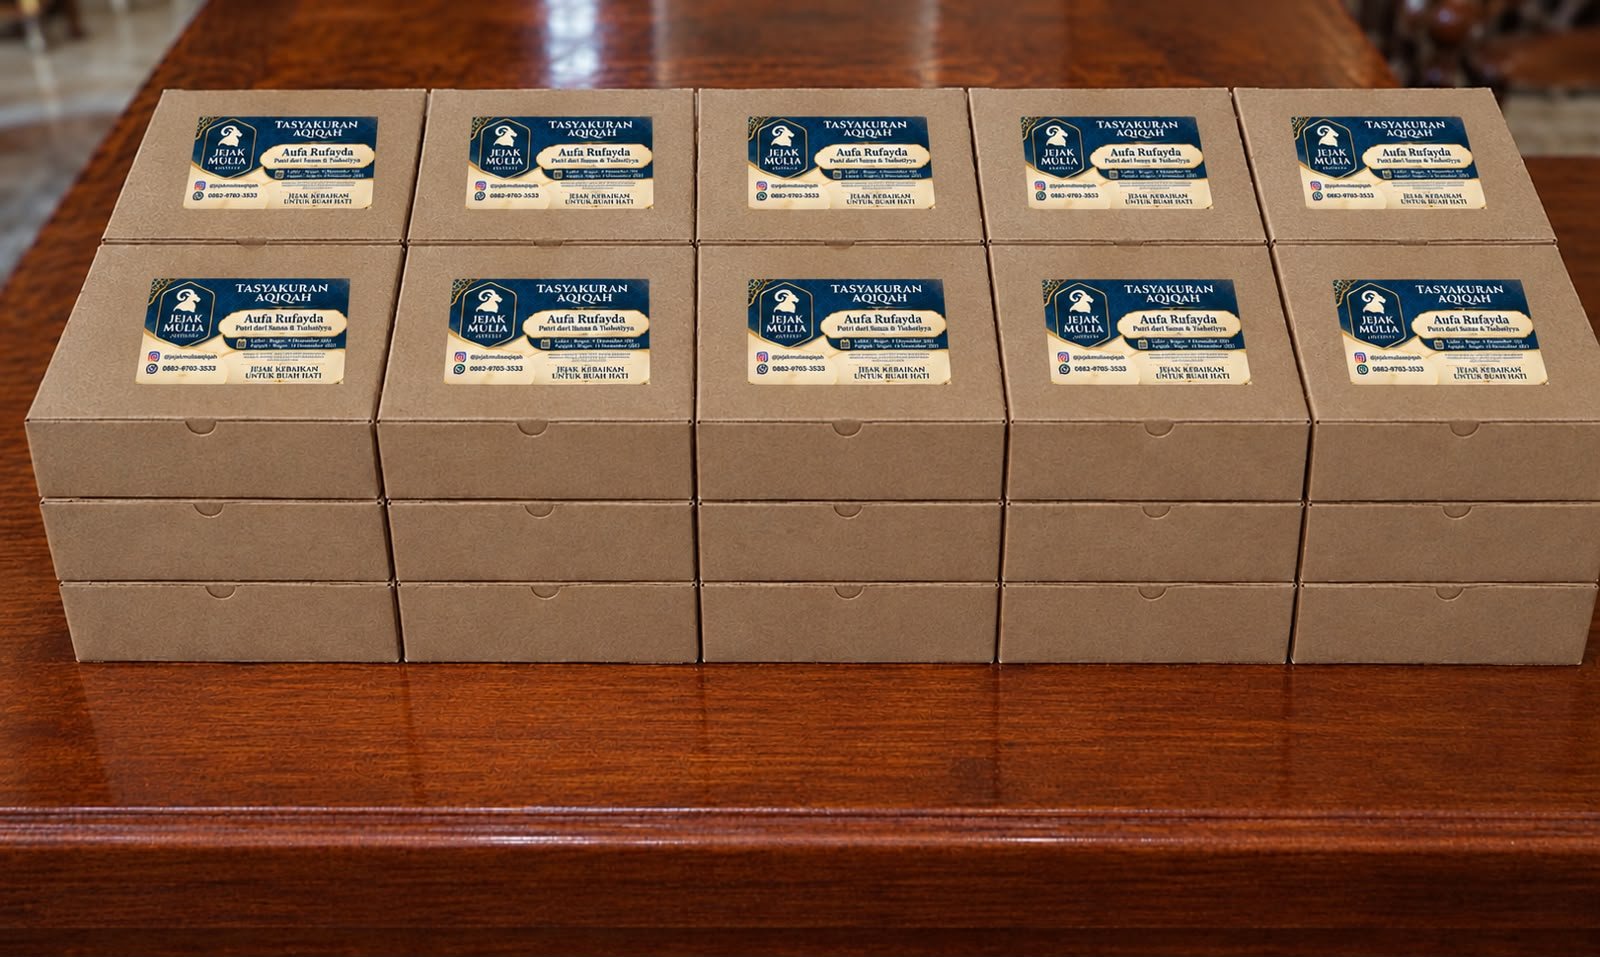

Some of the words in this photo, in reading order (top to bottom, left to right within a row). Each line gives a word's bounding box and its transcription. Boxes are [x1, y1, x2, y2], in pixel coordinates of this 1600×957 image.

[548, 121, 633, 129] TASYAKURAN
[1095, 121, 1178, 129] TASYAKURAN
[1365, 121, 1445, 129] TASYAKURAN
[292, 129, 343, 138] AQIQAH
[566, 129, 617, 138] AQIQAH
[842, 129, 893, 138] AQIQAH
[1115, 129, 1165, 138] AQIQAH
[1385, 129, 1434, 138] AQIQAH
[213, 148, 245, 157] JEJAK
[282, 148, 308, 156] Aufa
[310, 148, 354, 158] Rufayda
[489, 149, 521, 158] JEJAK
[558, 148, 584, 156] Aufa
[587, 148, 630, 158] Rufayda
[768, 148, 799, 157] JEJAK
[836, 148, 862, 156] Aufa
[864, 148, 908, 158] Rufayda
[1043, 149, 1075, 158] JEJAK
[1110, 148, 1135, 156] Aufa
[1138, 148, 1181, 158] Rufayda
[1316, 149, 1347, 158] JEJAK
[1381, 148, 1407, 156] Aufa
[1408, 148, 1451, 158] Rufayda
[208, 157, 246, 165] MULIA
[485, 157, 523, 165] MULIA
[764, 157, 802, 165] MULIA
[1041, 157, 1078, 165] MULIA
[1314, 157, 1351, 165] MULIA
[235, 284, 328, 292] TASYAKURAN
[536, 284, 628, 293] TASYAKURAN
[831, 284, 922, 293] TASYAKURAN
[1124, 285, 1214, 293] TASYAKURAN
[1415, 285, 1504, 294] TASYAKURAN
[255, 293, 311, 303] AQIQAH
[557, 294, 612, 304] AQIQAH
[852, 294, 907, 304] AQIQAH
[1146, 294, 1200, 304] AQIQAH
[1437, 294, 1492, 304] AQIQAH
[168, 314, 203, 324] JEJAK
[244, 314, 272, 323] Aufa
[275, 314, 324, 325] Rufayda
[471, 315, 506, 325] JEJAK
[547, 314, 575, 323] Aufa
[578, 314, 626, 325] Rufayda
[770, 315, 804, 325] JEJAK
[844, 315, 872, 324] Aufa
[875, 314, 922, 325] Rufayda
[1066, 315, 1100, 325] JEJAK
[1139, 315, 1167, 324] Aufa
[1170, 314, 1217, 325] Rufayda
[1361, 315, 1395, 325] JEJAK
[1433, 315, 1461, 324] Aufa
[1463, 315, 1510, 326] Rufayda
[163, 324, 205, 332] MULIA
[467, 324, 508, 333] MULIA
[766, 325, 807, 333] MULIA
[1064, 325, 1104, 333] MULIA
[1359, 325, 1399, 333] MULIA
